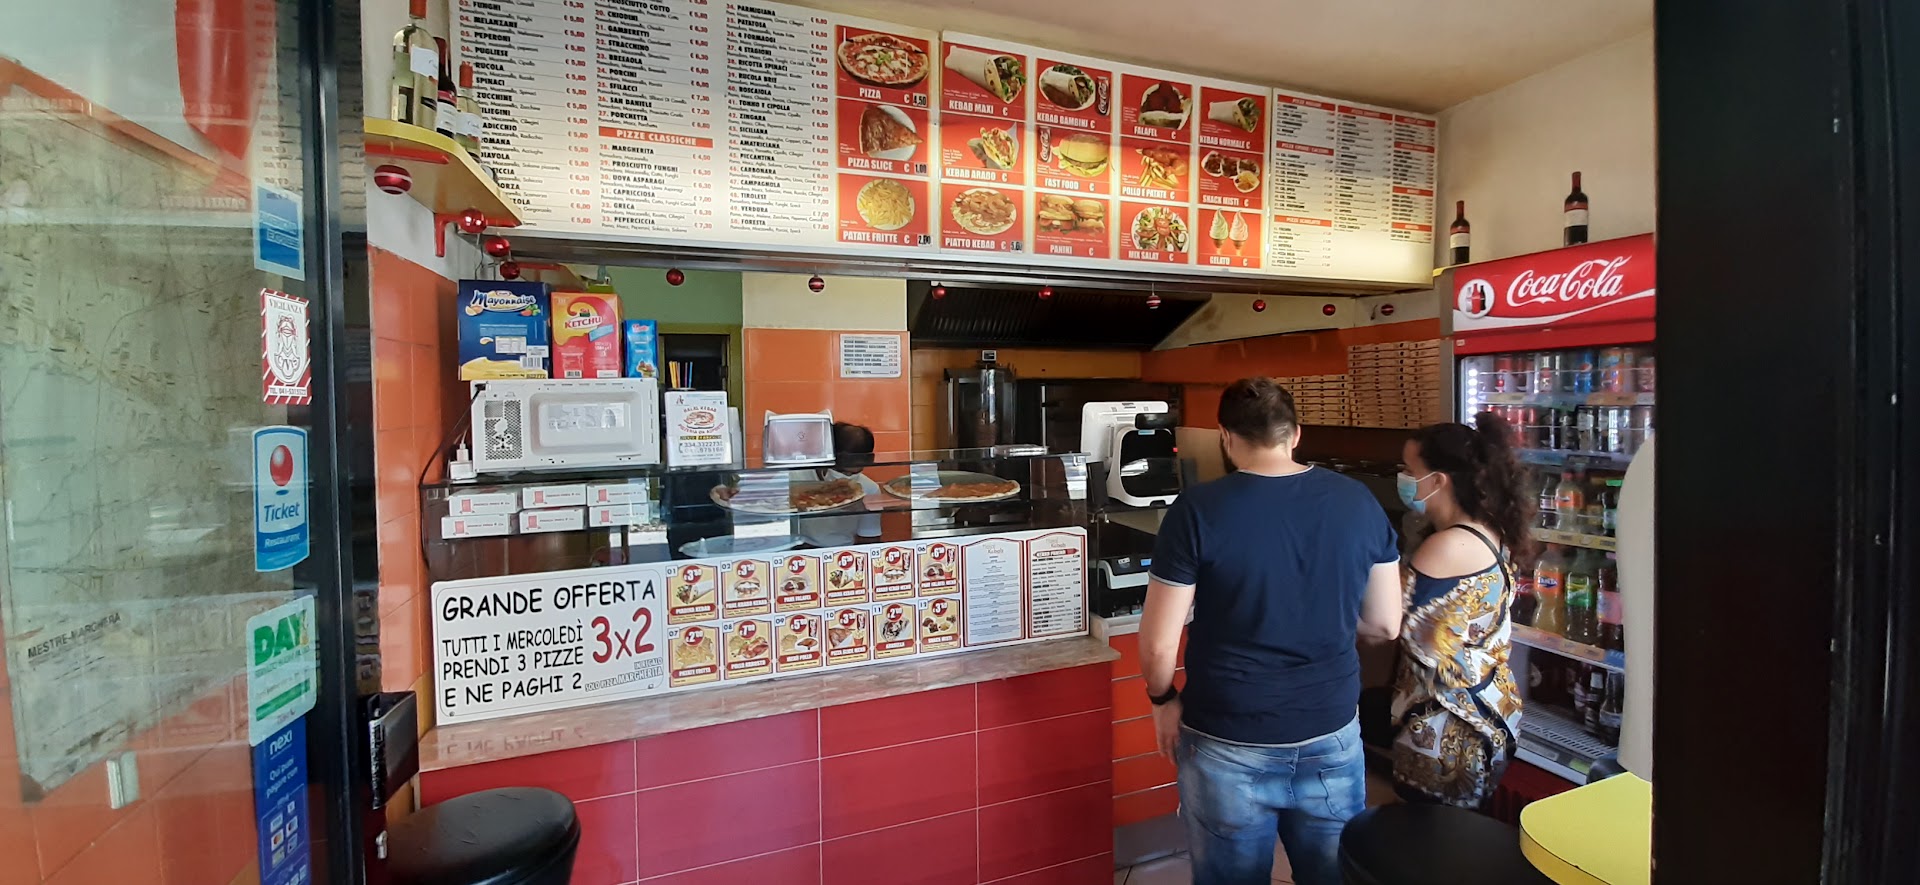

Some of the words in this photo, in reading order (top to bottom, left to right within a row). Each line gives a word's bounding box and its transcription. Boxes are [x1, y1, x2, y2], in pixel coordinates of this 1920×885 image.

[473, 1, 501, 11] FUNGHI
[650, 3, 671, 13] COTTO
[737, 5, 776, 16] PARMIGIANA
[607, 11, 639, 21] CHIODINI
[474, 16, 518, 28] MELANZANE
[737, 18, 767, 29] PATATOSA
[474, 32, 511, 42] PEPERONI
[608, 26, 650, 38] GAMBERETTI
[744, 33, 776, 43] FORMAGGI
[474, 46, 509, 57] PUGLIESE
[608, 40, 650, 52] STRACCHINO
[744, 46, 772, 56] STAGIONI
[608, 54, 643, 65] BRESAOLA
[475, 62, 505, 71] RUCOLA
[738, 60, 763, 69] RICOTTA
[764, 62, 788, 72] SPINACI
[609, 68, 638, 78] PORCINI
[739, 72, 762, 81] RUCOLA
[476, 77, 505, 86] SPINACI
[610, 82, 638, 92] SFILACCI
[477, 92, 513, 101] ZUCCHINE
[739, 86, 772, 96] BOSCAIOLA
[859, 88, 882, 100] PIZZA
[904, 94, 910, 104] €
[610, 97, 624, 105] SAN
[625, 98, 652, 108] DANIELE
[739, 100, 760, 108] TONNO
[767, 103, 790, 111] CIPOLLA
[949, 100, 974, 113] KEBAB
[975, 104, 994, 114] MAXI
[1002, 106, 1008, 116] €
[481, 107, 511, 116] ILIEGINI
[610, 111, 648, 121] PORCHETTA
[740, 113, 766, 121] ZINGARA
[1036, 112, 1059, 124] KEBAB
[1060, 115, 1089, 128] BAMBINI
[1090, 120, 1096, 129] €
[482, 122, 518, 131] ADICCHIO
[740, 126, 768, 135] SICILIANA
[1134, 126, 1158, 137] FALAFEL
[616, 130, 646, 140] PIZZE
[648, 133, 697, 146] CLASSICHE
[1200, 136, 1218, 145] KEBAB
[1219, 138, 1245, 148] NORMALE
[612, 145, 655, 155] MARGHERITA
[740, 140, 780, 149] AMATRICIANA
[740, 153, 775, 161] PICCANTINA
[612, 161, 652, 170] PROSCIUTTO
[654, 164, 679, 173] FUNGHI
[740, 166, 777, 175] CARBONARA
[847, 157, 870, 168] PIZZA
[871, 160, 893, 171] SLICE
[904, 162, 910, 173] €
[633, 176, 665, 185] ASPARAGI
[945, 168, 971, 179] KEBAB
[971, 170, 996, 180] ARABO
[1002, 173, 1008, 182] €
[741, 180, 781, 188] CAMPAGNOLA
[1044, 178, 1061, 189] FAST
[1062, 180, 1079, 190] FOOD
[613, 189, 656, 198] CAPRICCIOSA
[741, 192, 767, 200] TIROLESE
[1122, 186, 1141, 197] POLLO
[1142, 189, 1145, 197] E
[1146, 190, 1167, 199] PATATE
[1203, 195, 1222, 204] SNACK
[1223, 197, 1240, 206] MISTI
[842, 230, 870, 241] PATATE
[871, 232, 898, 244] FRITTE
[904, 234, 910, 244] €
[945, 238, 971, 248] PIATTO
[972, 240, 996, 250] KEBAB
[1050, 244, 1073, 254] PANINI
[1128, 250, 1140, 259] MIX
[1141, 251, 1159, 260] SALAT
[1210, 256, 1230, 265] GELATO
[1506, 255, 1632, 307] Coca-Cola
[471, 290, 536, 308] Mayonnaise
[270, 298, 302, 314] VIGILANZA
[264, 501, 300, 523] Ticket
[442, 588, 543, 621] GRANDE
[554, 580, 656, 610] OFFERTA
[28, 612, 121, 658] MESTRE-MARGHERA
[254, 609, 308, 666] DAY
[442, 635, 487, 657] TUTTI
[494, 634, 501, 651] I
[506, 619, 584, 651] MERCOLEDÌ
[590, 607, 655, 664] 3x2
[443, 656, 510, 681] PRENDI
[518, 654, 527, 671] 3
[534, 646, 584, 670] PIZZE
[585, 681, 600, 692] SOLO
[600, 677, 618, 690] PIZZA
[617, 667, 664, 685] MARGHERITA
[444, 688, 456, 708] E
[466, 684, 493, 706] NE
[502, 675, 564, 700] PAGHI
[572, 672, 582, 690] 2
[270, 730, 293, 755] nexi
